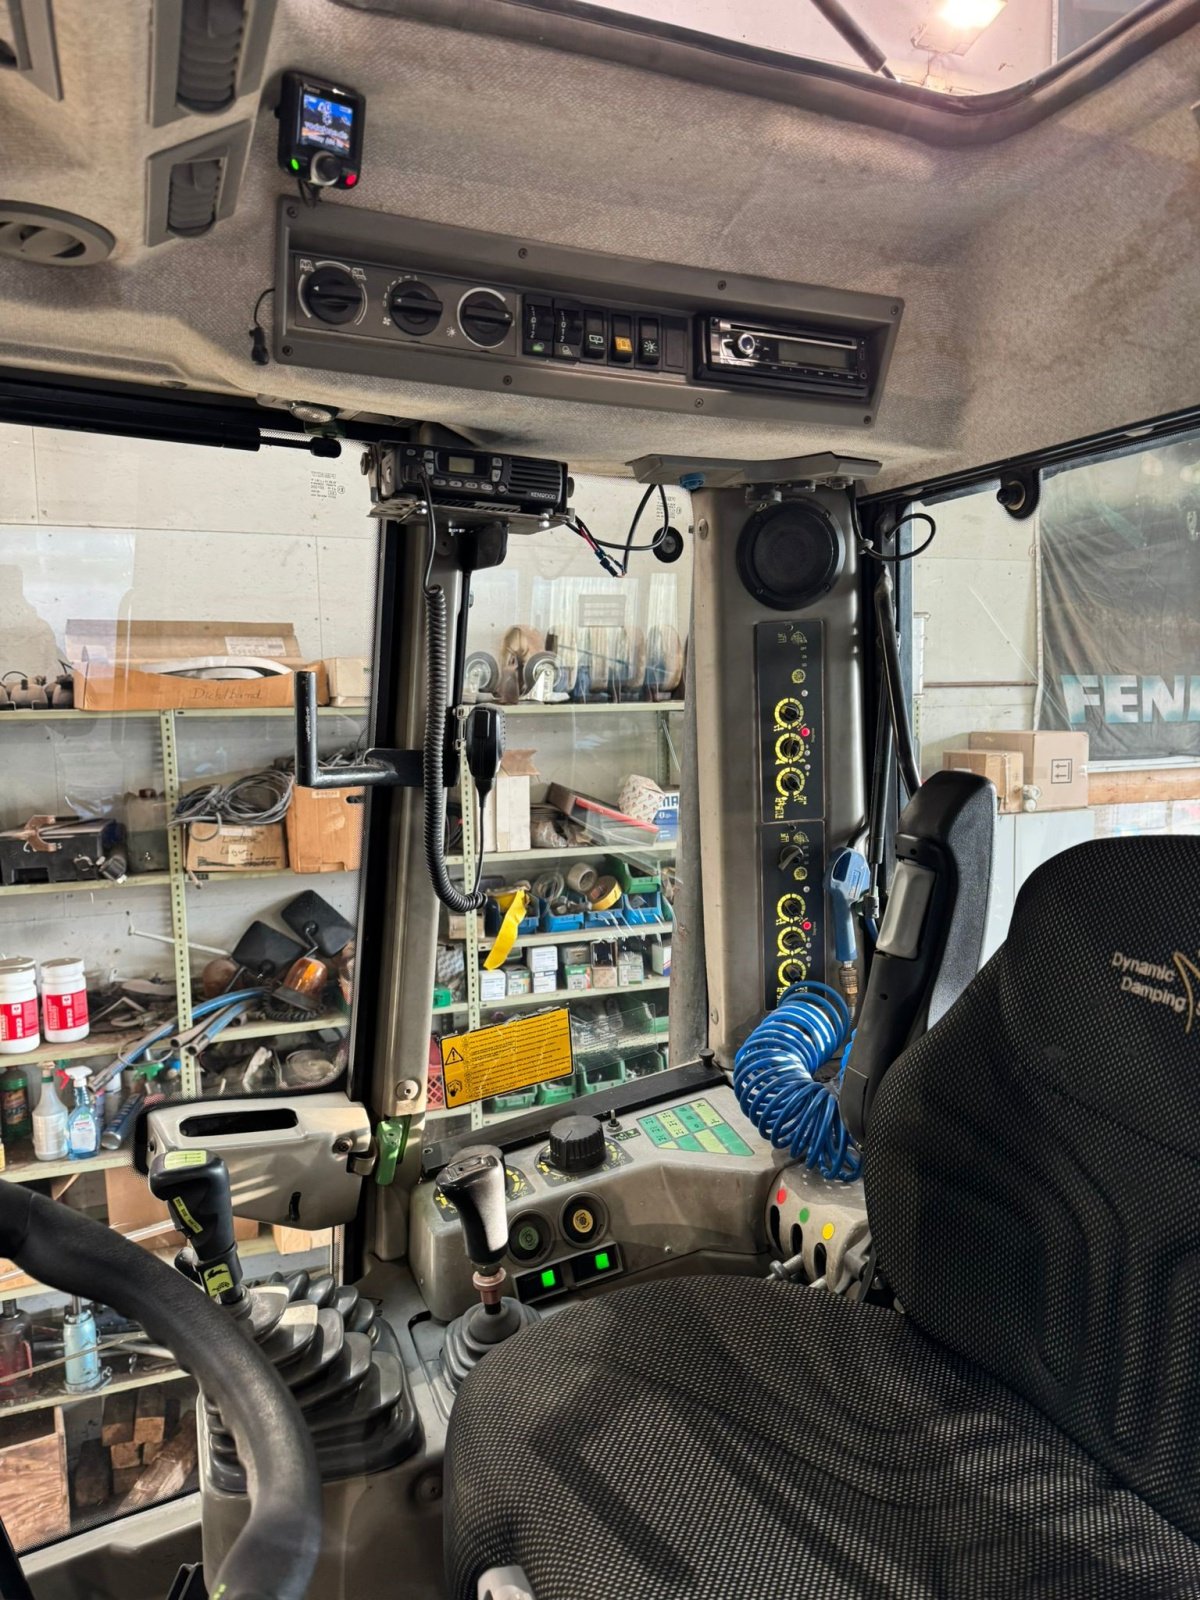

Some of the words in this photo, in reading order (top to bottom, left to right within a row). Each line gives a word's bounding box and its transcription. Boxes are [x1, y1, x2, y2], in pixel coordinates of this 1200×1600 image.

[530, 491, 556, 500] KENWOOD
[1112, 951, 1175, 982] Dynamic
[1121, 976, 1186, 1013] Damping
